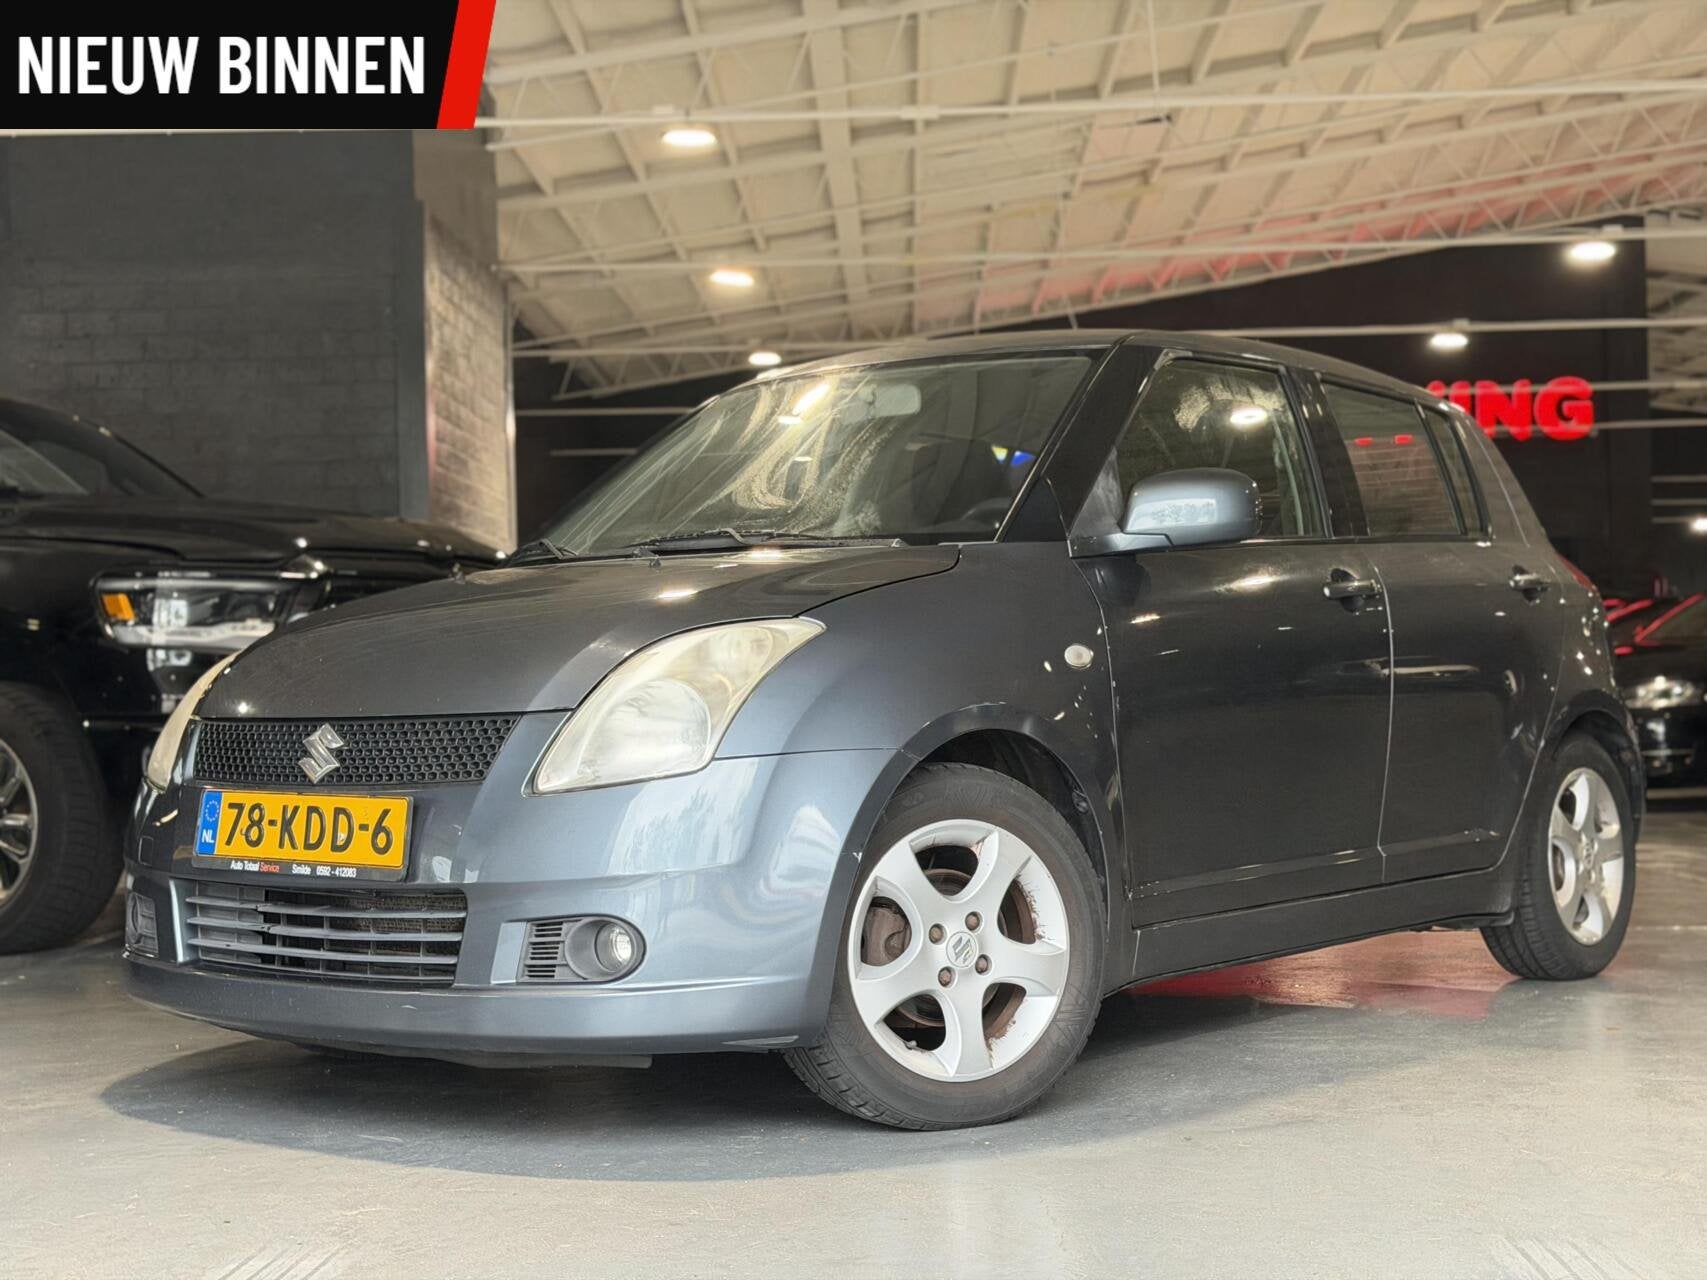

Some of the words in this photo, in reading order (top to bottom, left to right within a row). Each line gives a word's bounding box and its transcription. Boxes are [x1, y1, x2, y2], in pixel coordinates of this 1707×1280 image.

[201, 829, 215, 843] NL
[224, 802, 394, 856] 78-KDD-6
[230, 859, 244, 870] Auto
[260, 861, 280, 873] Service
